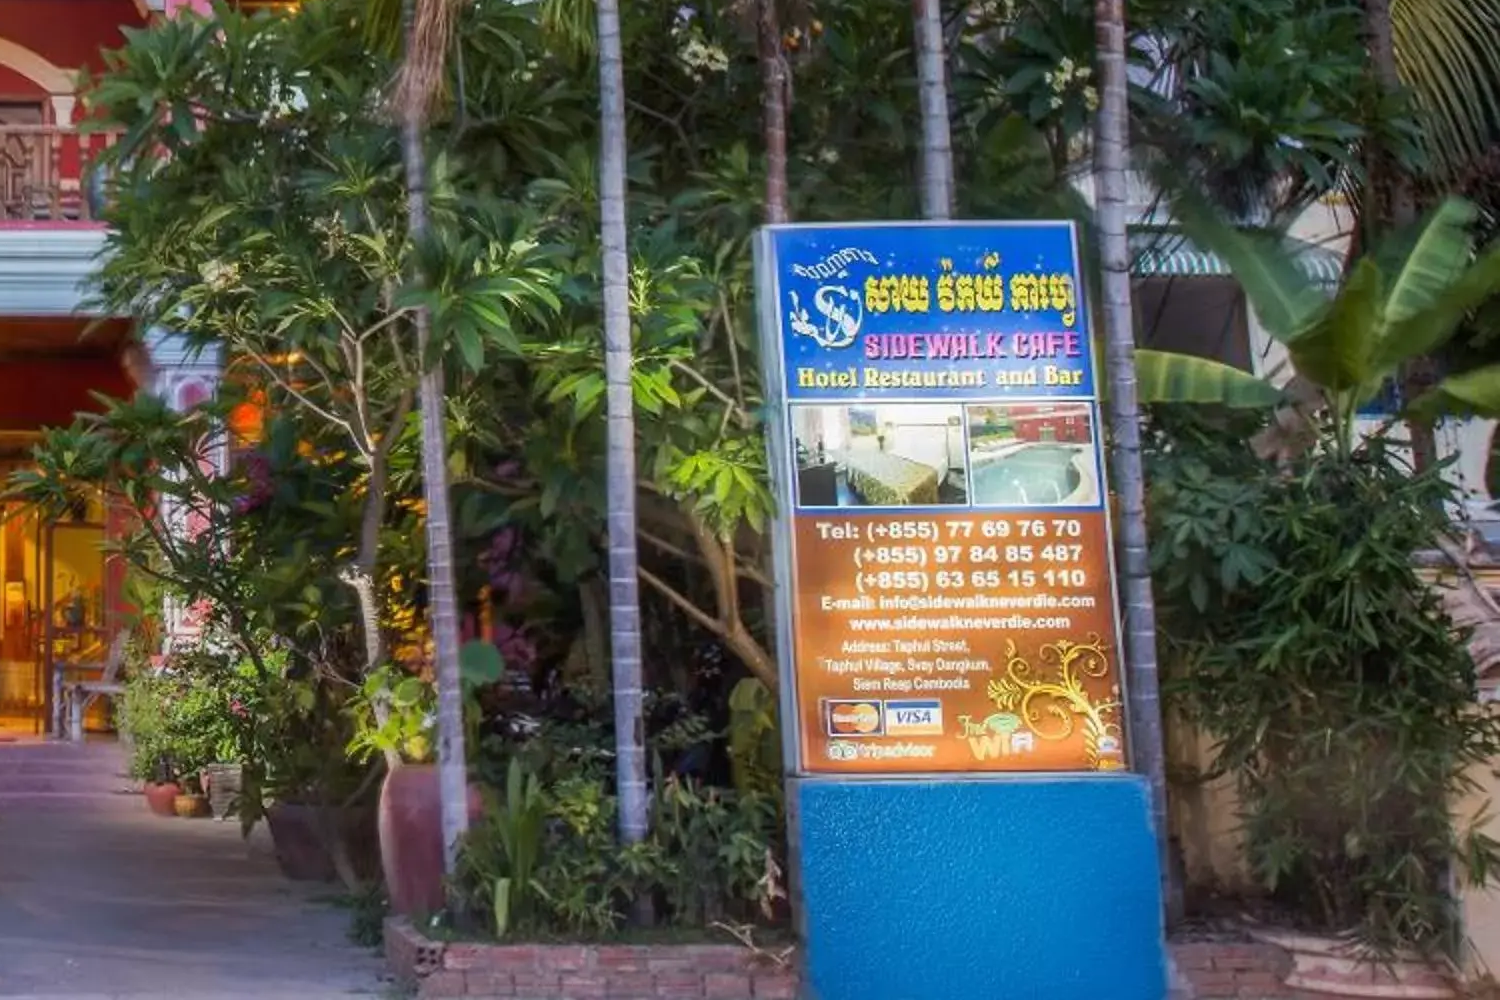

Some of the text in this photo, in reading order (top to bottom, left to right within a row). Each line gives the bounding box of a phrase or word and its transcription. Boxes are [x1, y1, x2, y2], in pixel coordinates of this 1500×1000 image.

[864, 331, 1081, 359] SIDEWALK CAFE
[798, 364, 1084, 387] Hotel Restaurant and Bar
[816, 520, 1082, 542] Tel: (+855) 77 69 76 70
[853, 545, 1083, 568] (+855) 97 84 85 487
[855, 571, 929, 592] (+855)
[936, 572, 964, 588] 63
[1008, 571, 1036, 588] 15
[1043, 570, 1086, 587] 110
[896, 711, 932, 724] VISA
